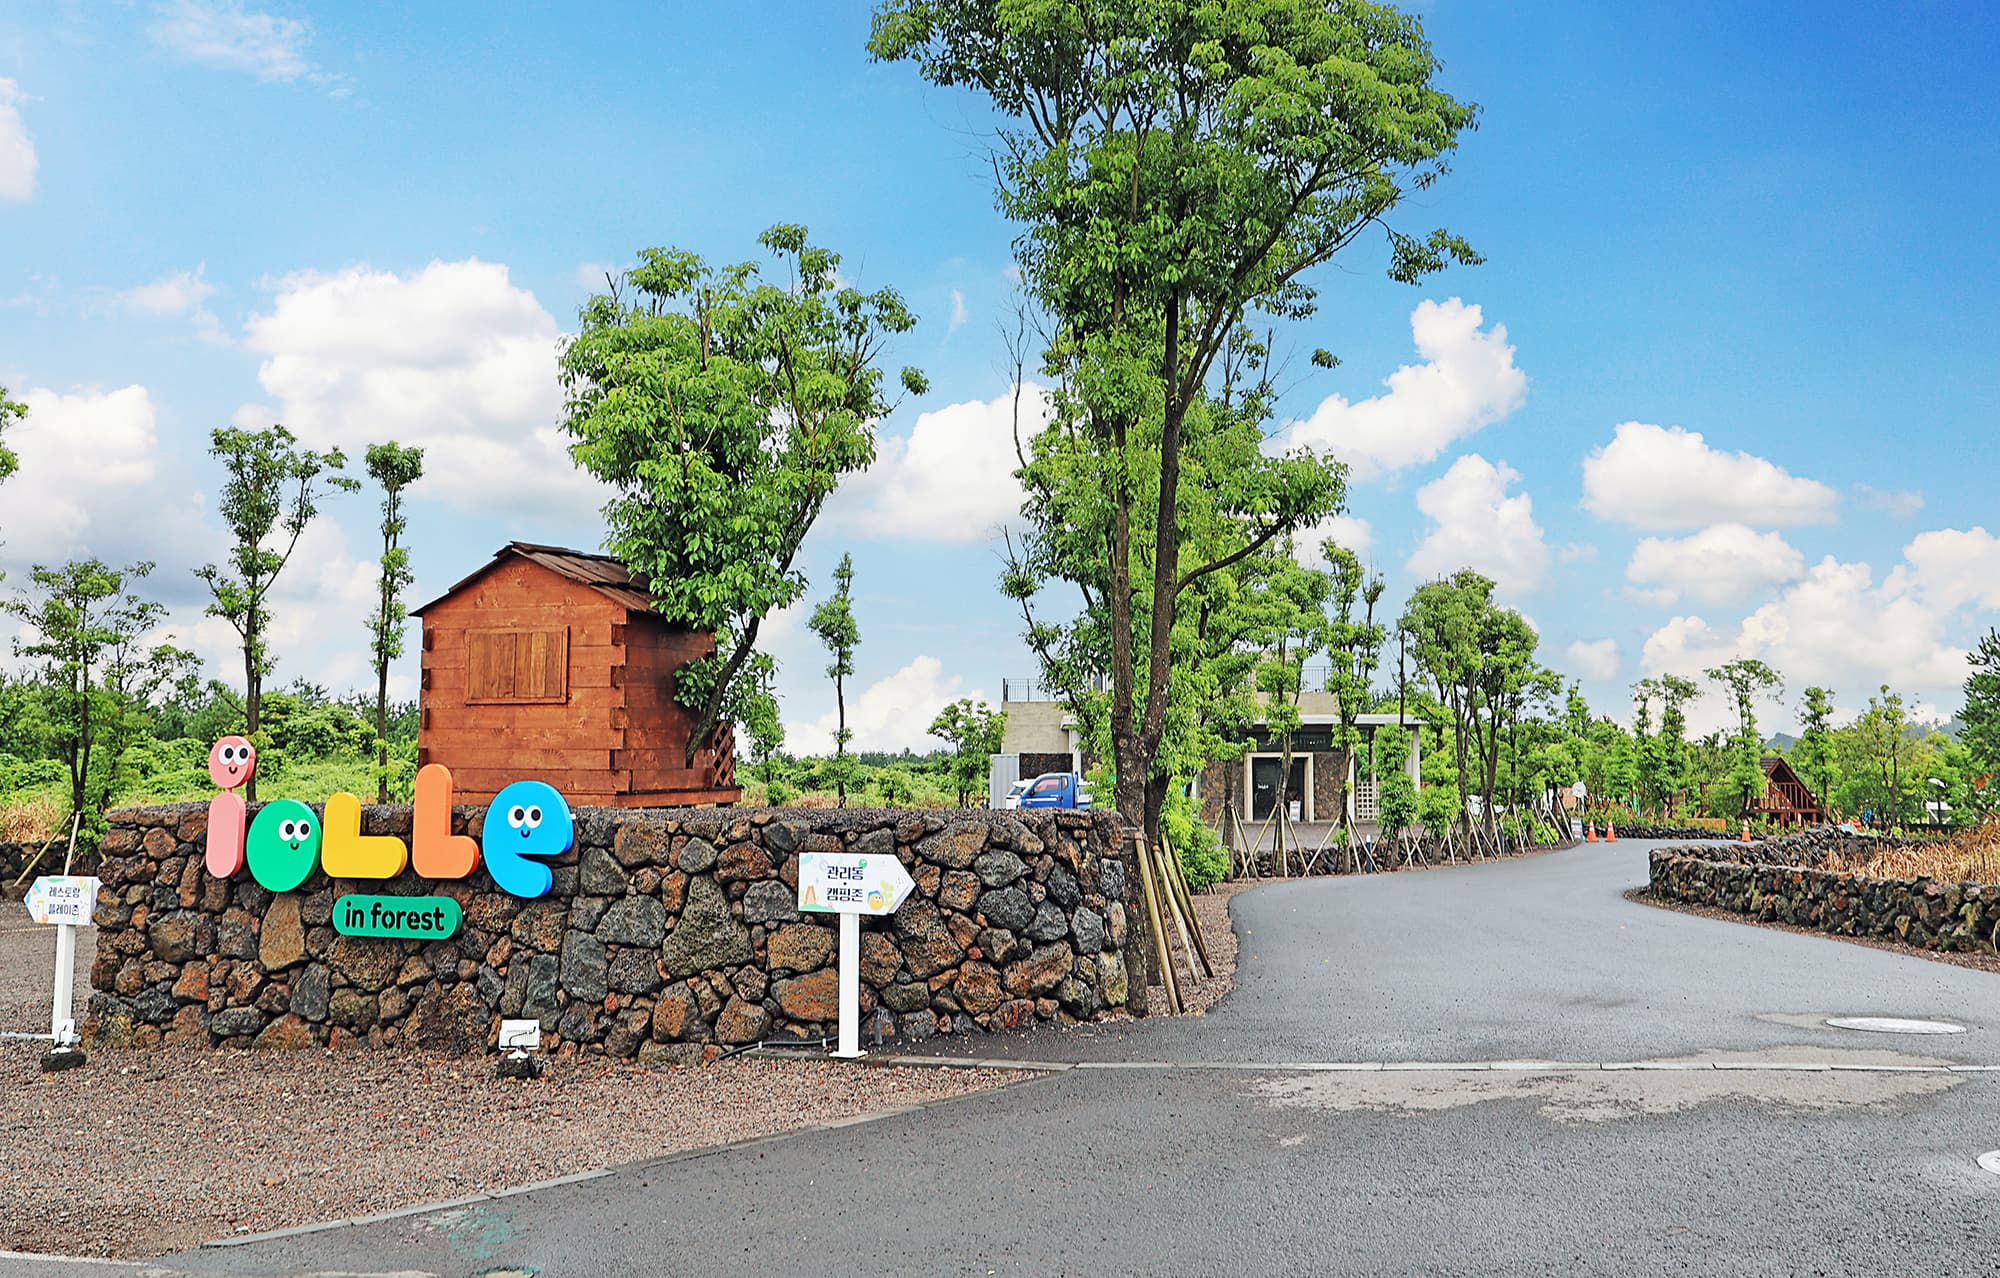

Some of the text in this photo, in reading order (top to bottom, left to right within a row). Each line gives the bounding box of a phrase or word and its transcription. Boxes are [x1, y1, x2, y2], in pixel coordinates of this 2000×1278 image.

[827, 865, 864, 880] 관리동
[49, 886, 80, 898] 레스토랑
[827, 887, 864, 902] 캠핑존
[345, 900, 445, 931] in forest
